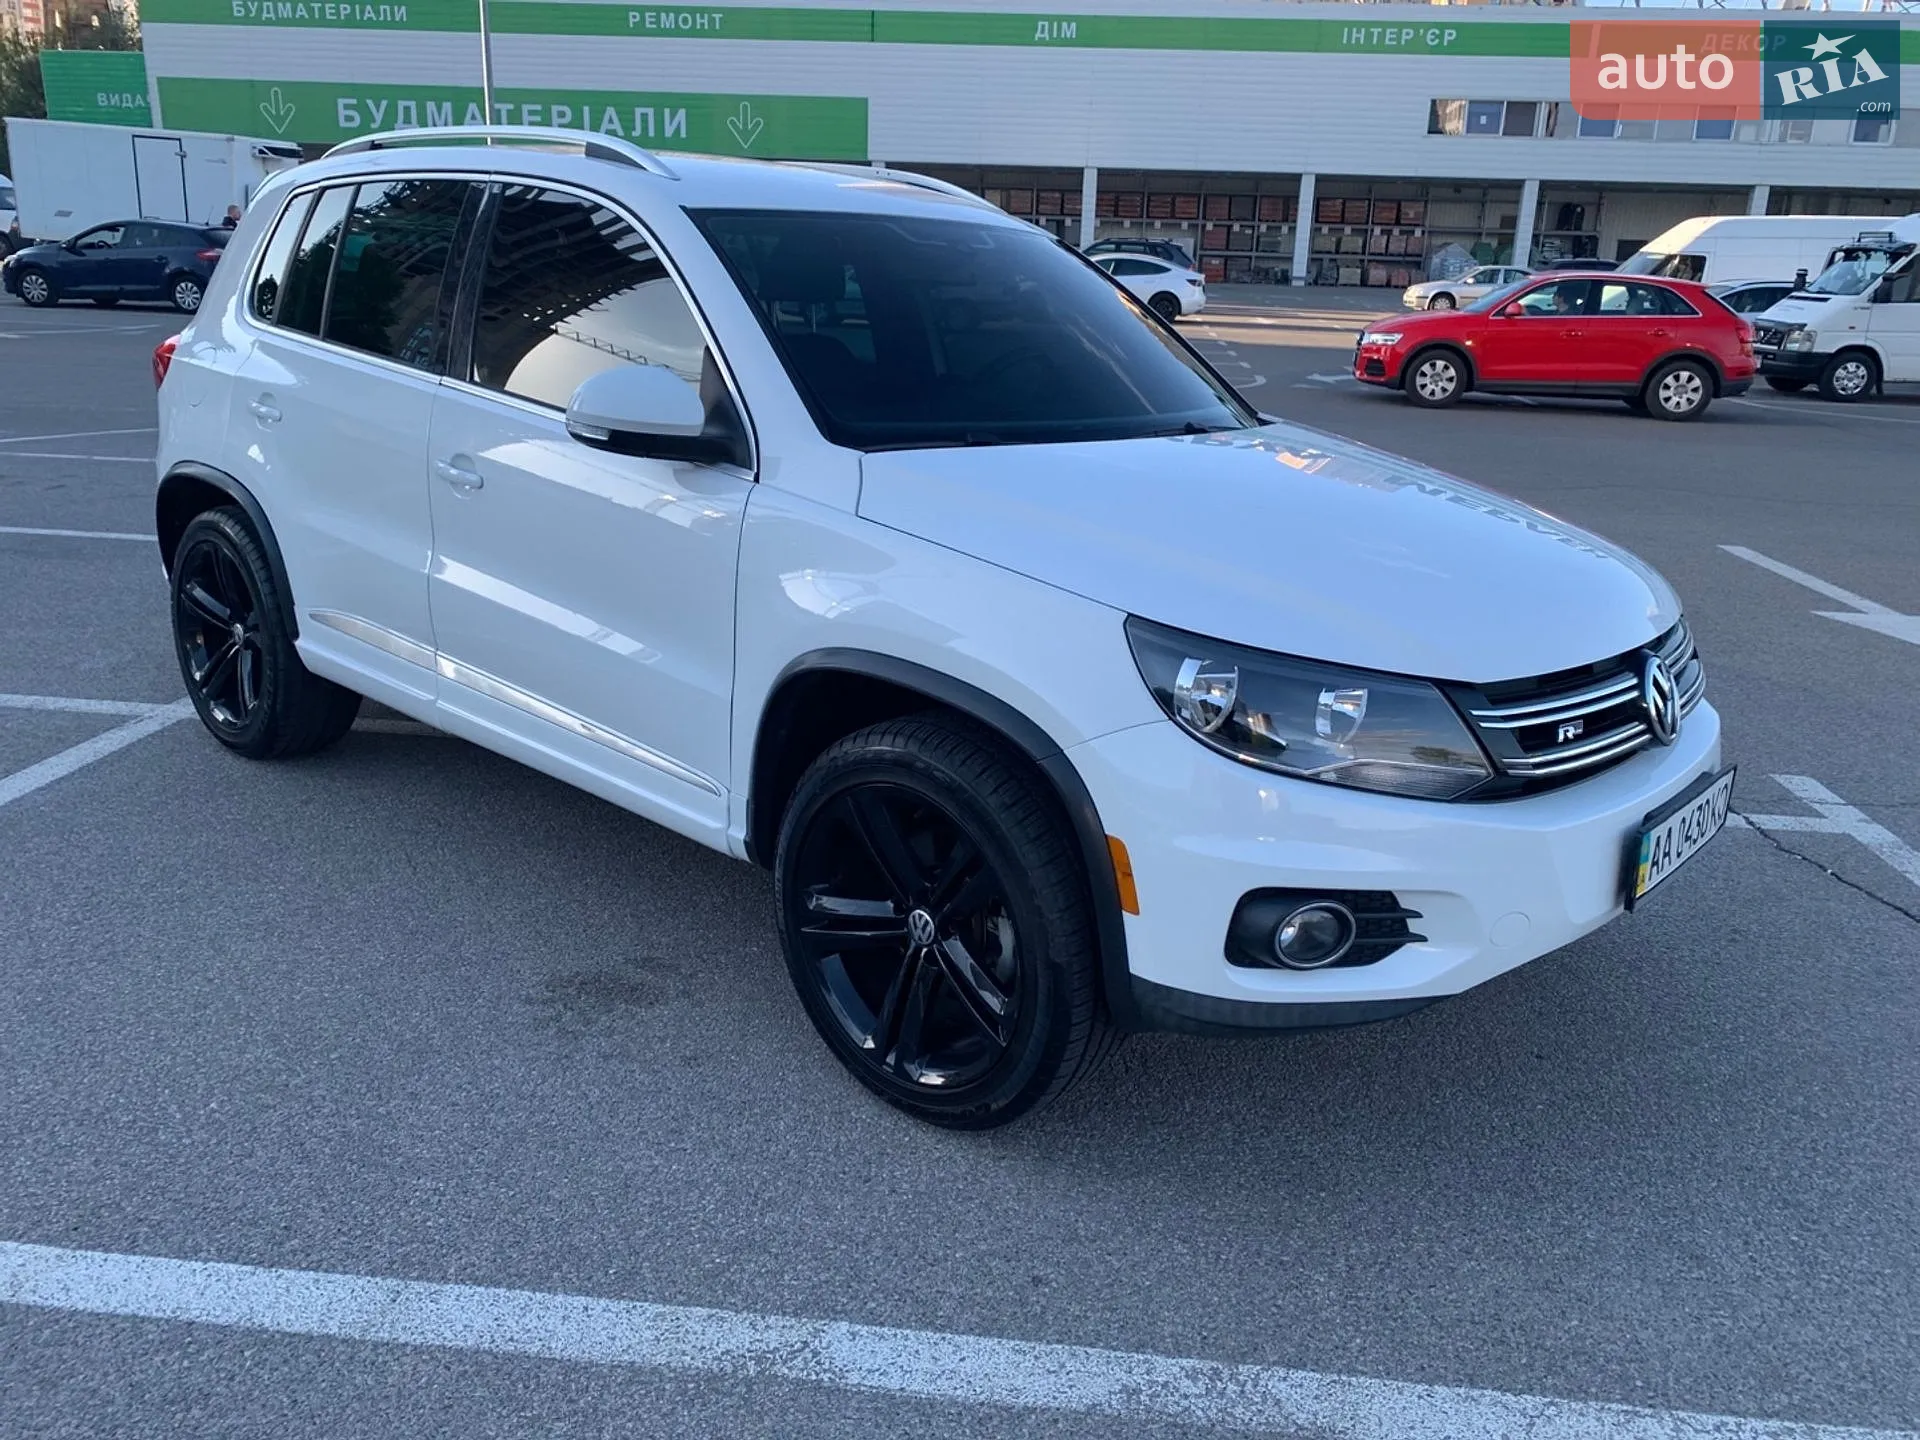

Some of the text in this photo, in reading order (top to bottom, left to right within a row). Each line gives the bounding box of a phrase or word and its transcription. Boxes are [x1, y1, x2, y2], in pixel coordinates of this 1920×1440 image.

[231, 1, 408, 22] БУДМАТЕРІАЛИ
[628, 11, 724, 30] РЕМОНТ
[1035, 21, 1077, 41] ДІМ
[97, 92, 150, 109] ВИДА
[336, 97, 688, 139] БУДМАТЕРІАЛИ
